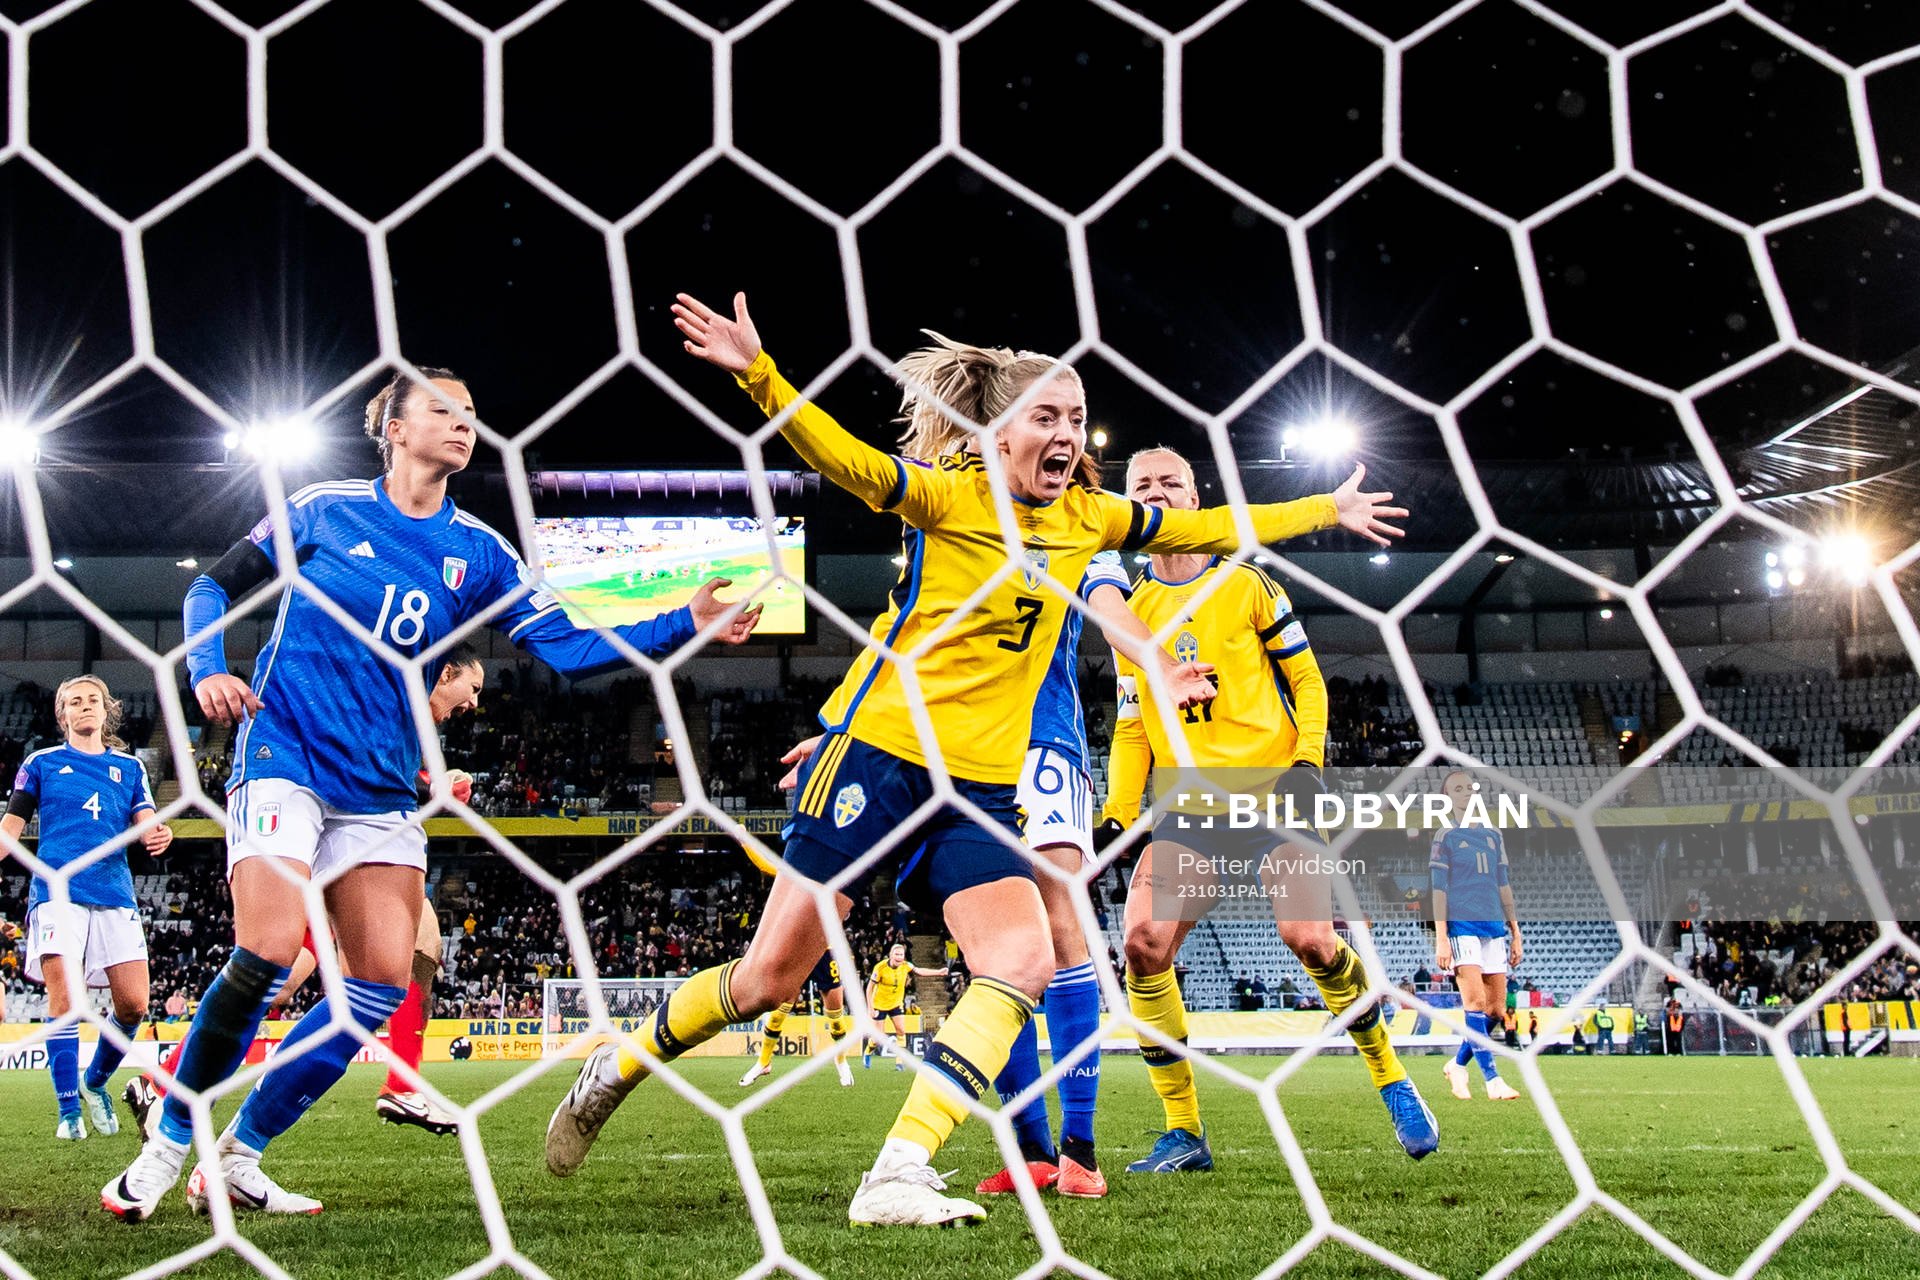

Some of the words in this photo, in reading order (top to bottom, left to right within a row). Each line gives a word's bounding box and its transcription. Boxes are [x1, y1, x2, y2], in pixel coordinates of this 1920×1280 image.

[372, 584, 430, 646] 18
[997, 596, 1044, 653] 3
[1033, 747, 1064, 795] 6
[81, 791, 102, 821] 4
[1476, 851, 1489, 874] 11
